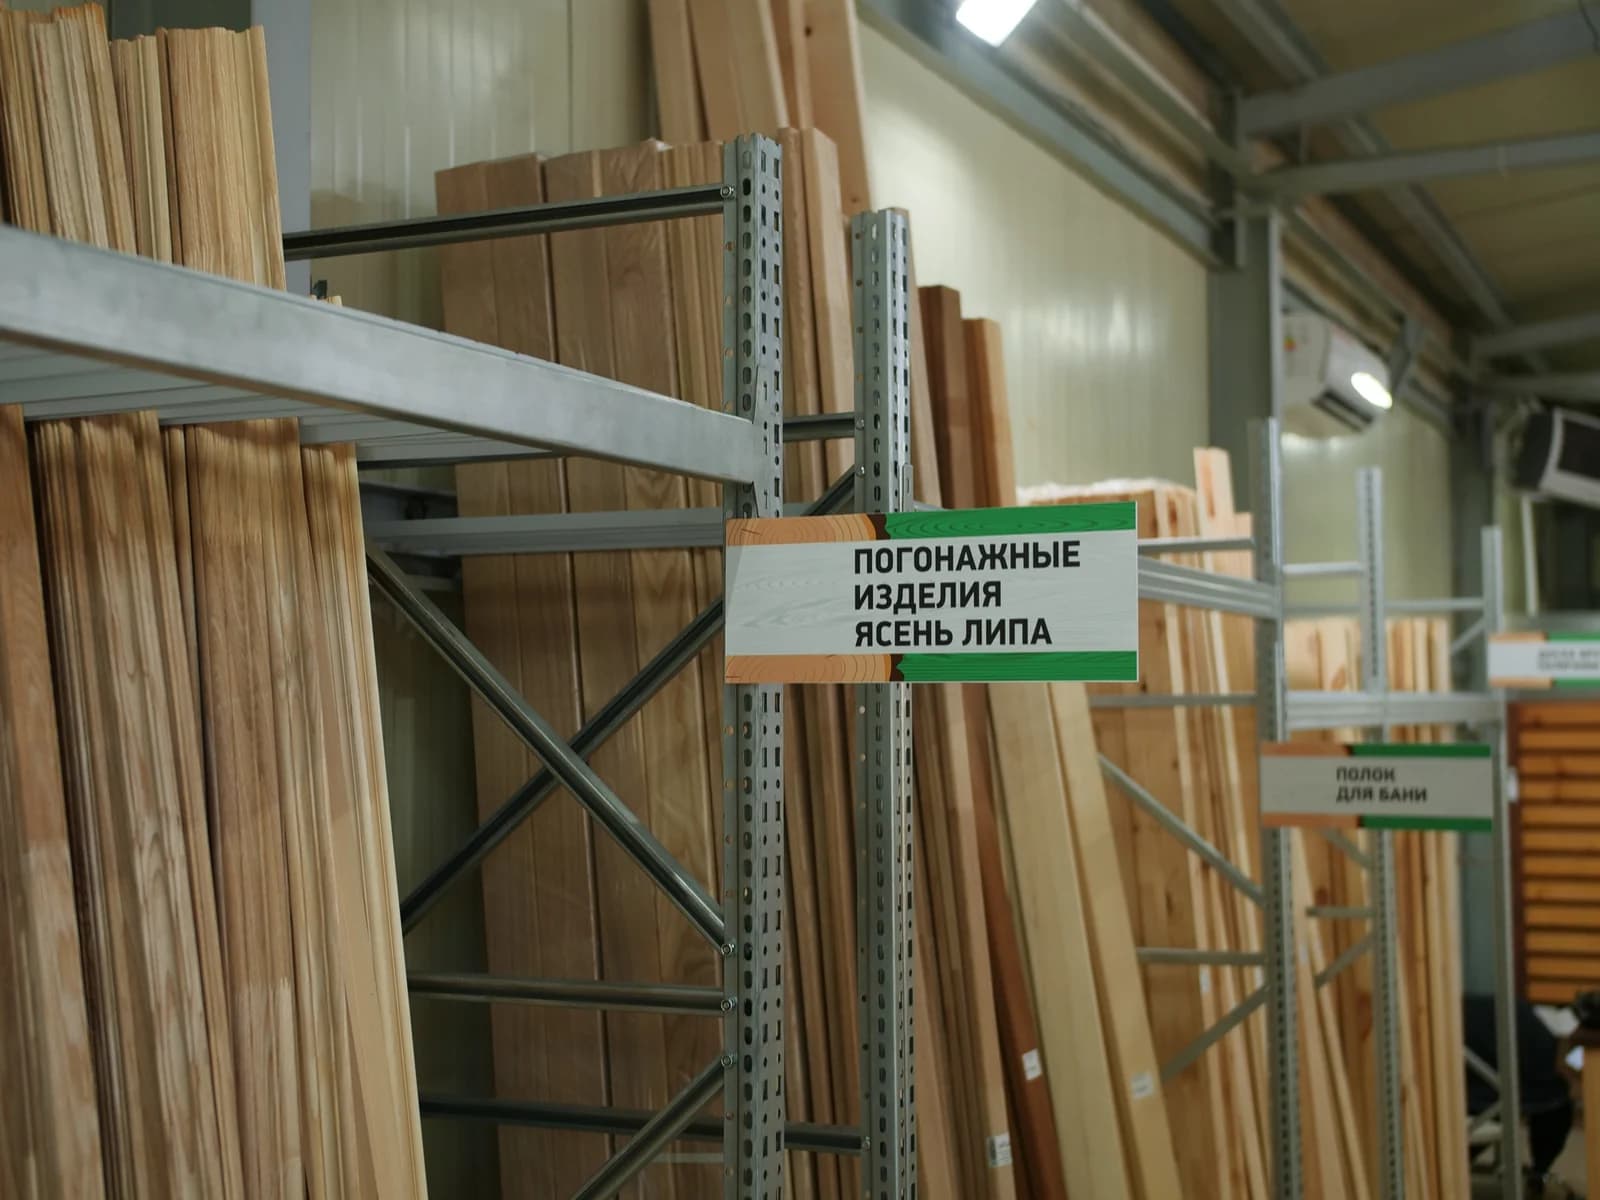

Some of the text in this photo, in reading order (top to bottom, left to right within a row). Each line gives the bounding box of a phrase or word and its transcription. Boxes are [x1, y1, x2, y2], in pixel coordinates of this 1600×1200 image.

[854, 540, 1081, 574] ПОГОНАЖНЫЕ
[854, 581, 1001, 615] ИЗДЕЛИЯ
[855, 618, 1053, 647] ЯСЕНЬ ЛИПА
[1336, 767, 1395, 782] ПОЛОК
[1336, 786, 1427, 803] ДЛЯ БАНИ
